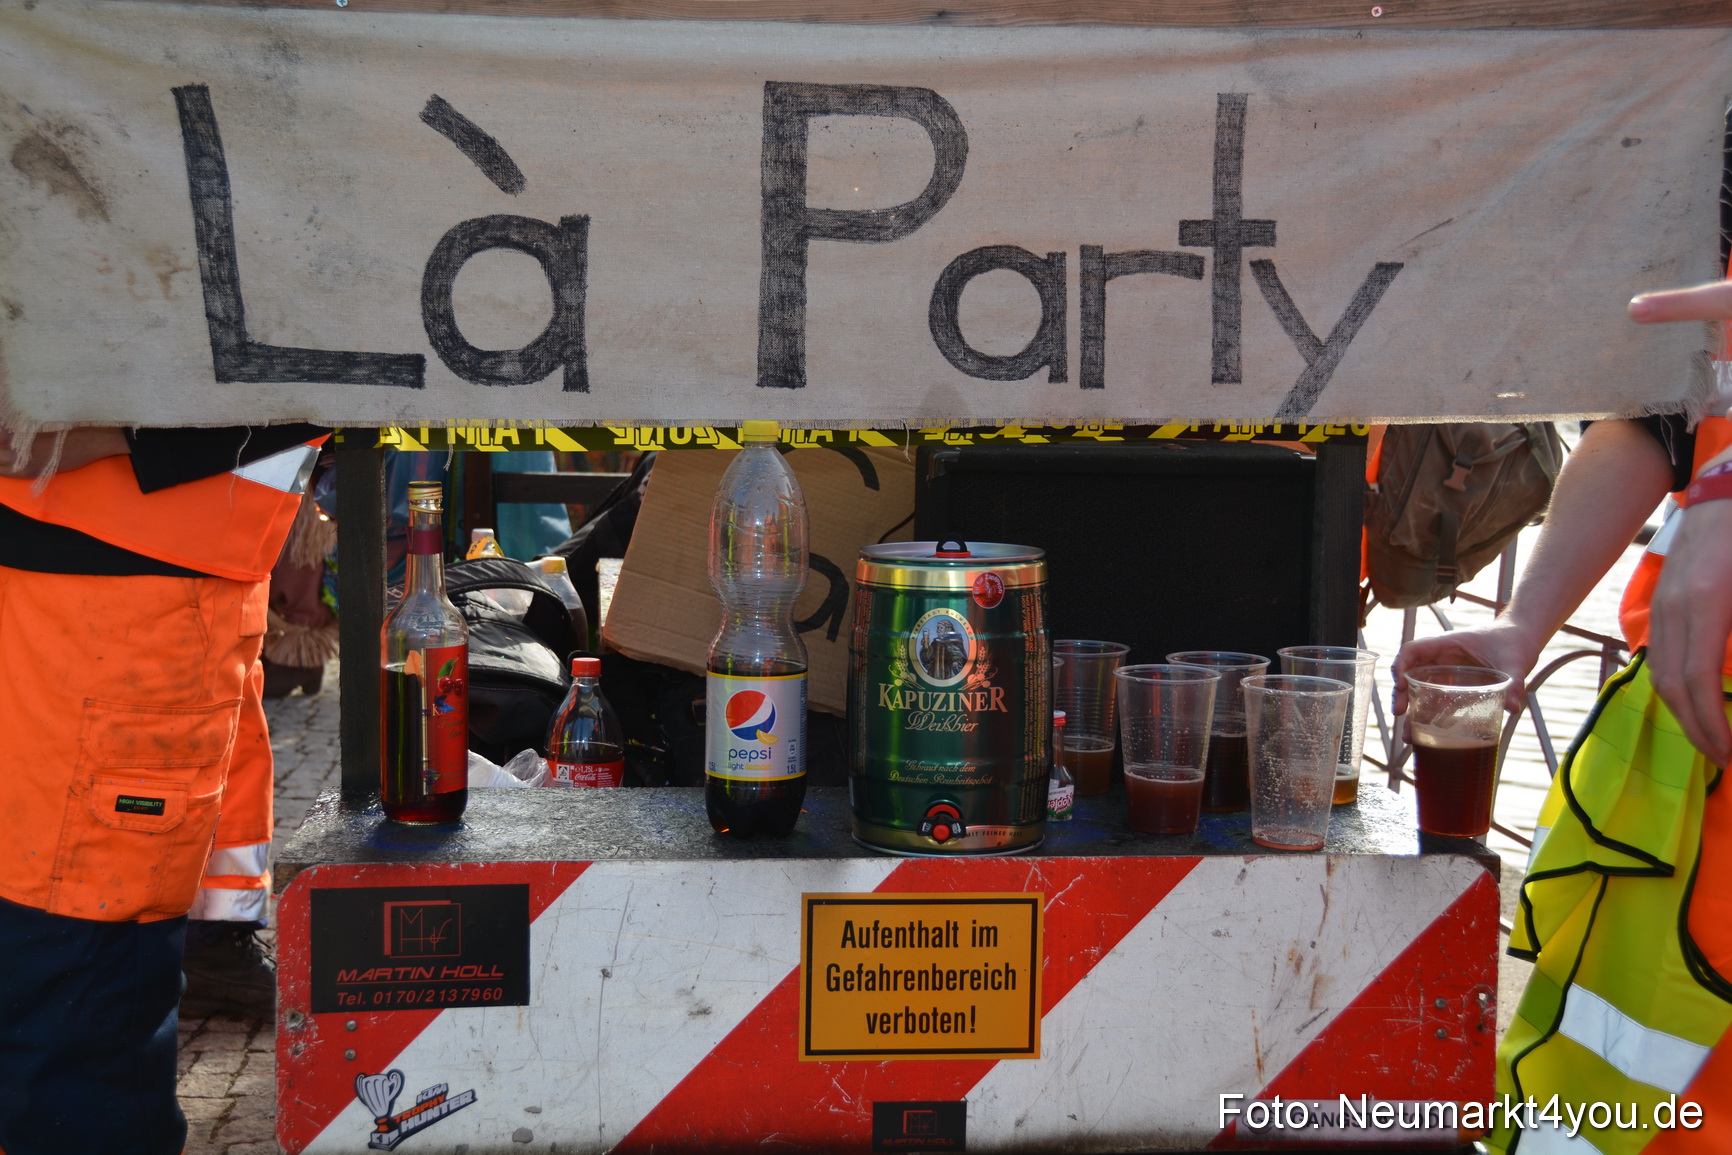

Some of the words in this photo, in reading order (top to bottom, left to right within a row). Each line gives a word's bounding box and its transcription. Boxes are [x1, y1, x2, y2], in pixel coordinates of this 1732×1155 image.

[170, 84, 590, 392] Là
[757, 80, 1404, 418] Party
[878, 683, 1008, 713] KAPUZINER
[905, 711, 979, 732] Weißbier
[728, 747, 772, 762] pepsi
[840, 919, 959, 949] Aufenthalt
[971, 919, 998, 948] im
[337, 966, 435, 982] MARTIN
[440, 964, 504, 979] HOLL
[826, 962, 1017, 992] Gefahrenbereich
[337, 992, 366, 1006] Tel.
[372, 987, 504, 1004] 0170/2137960
[866, 1005, 976, 1034] verboten!
[393, 1094, 447, 1124] TROPHY
[401, 1089, 474, 1133] HUNTER
[927, 1137, 955, 1145] HOLL
